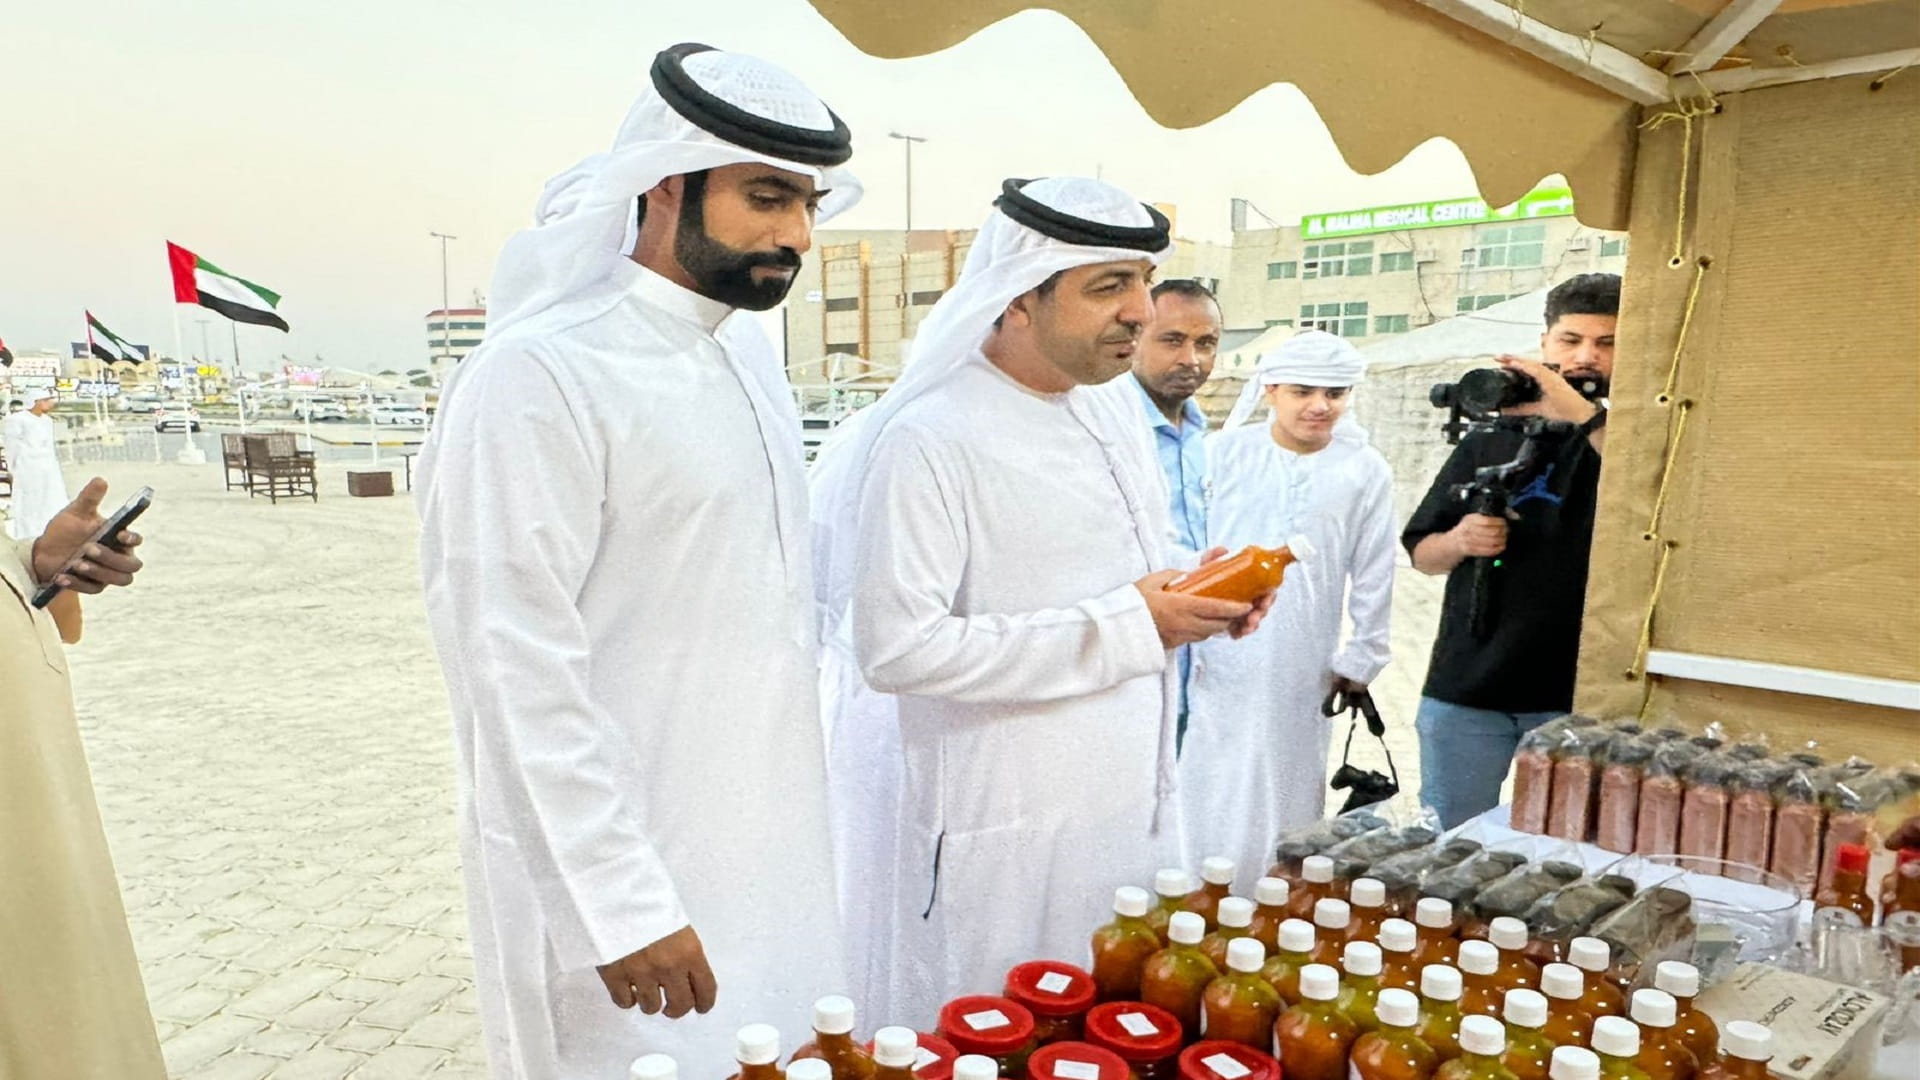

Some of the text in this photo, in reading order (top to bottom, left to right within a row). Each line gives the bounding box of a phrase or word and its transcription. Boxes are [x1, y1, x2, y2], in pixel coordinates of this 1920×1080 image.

[1307, 217, 1323, 235] AL
[1373, 206, 1429, 228] MEDICAL
[1432, 202, 1486, 221] CENTRE
